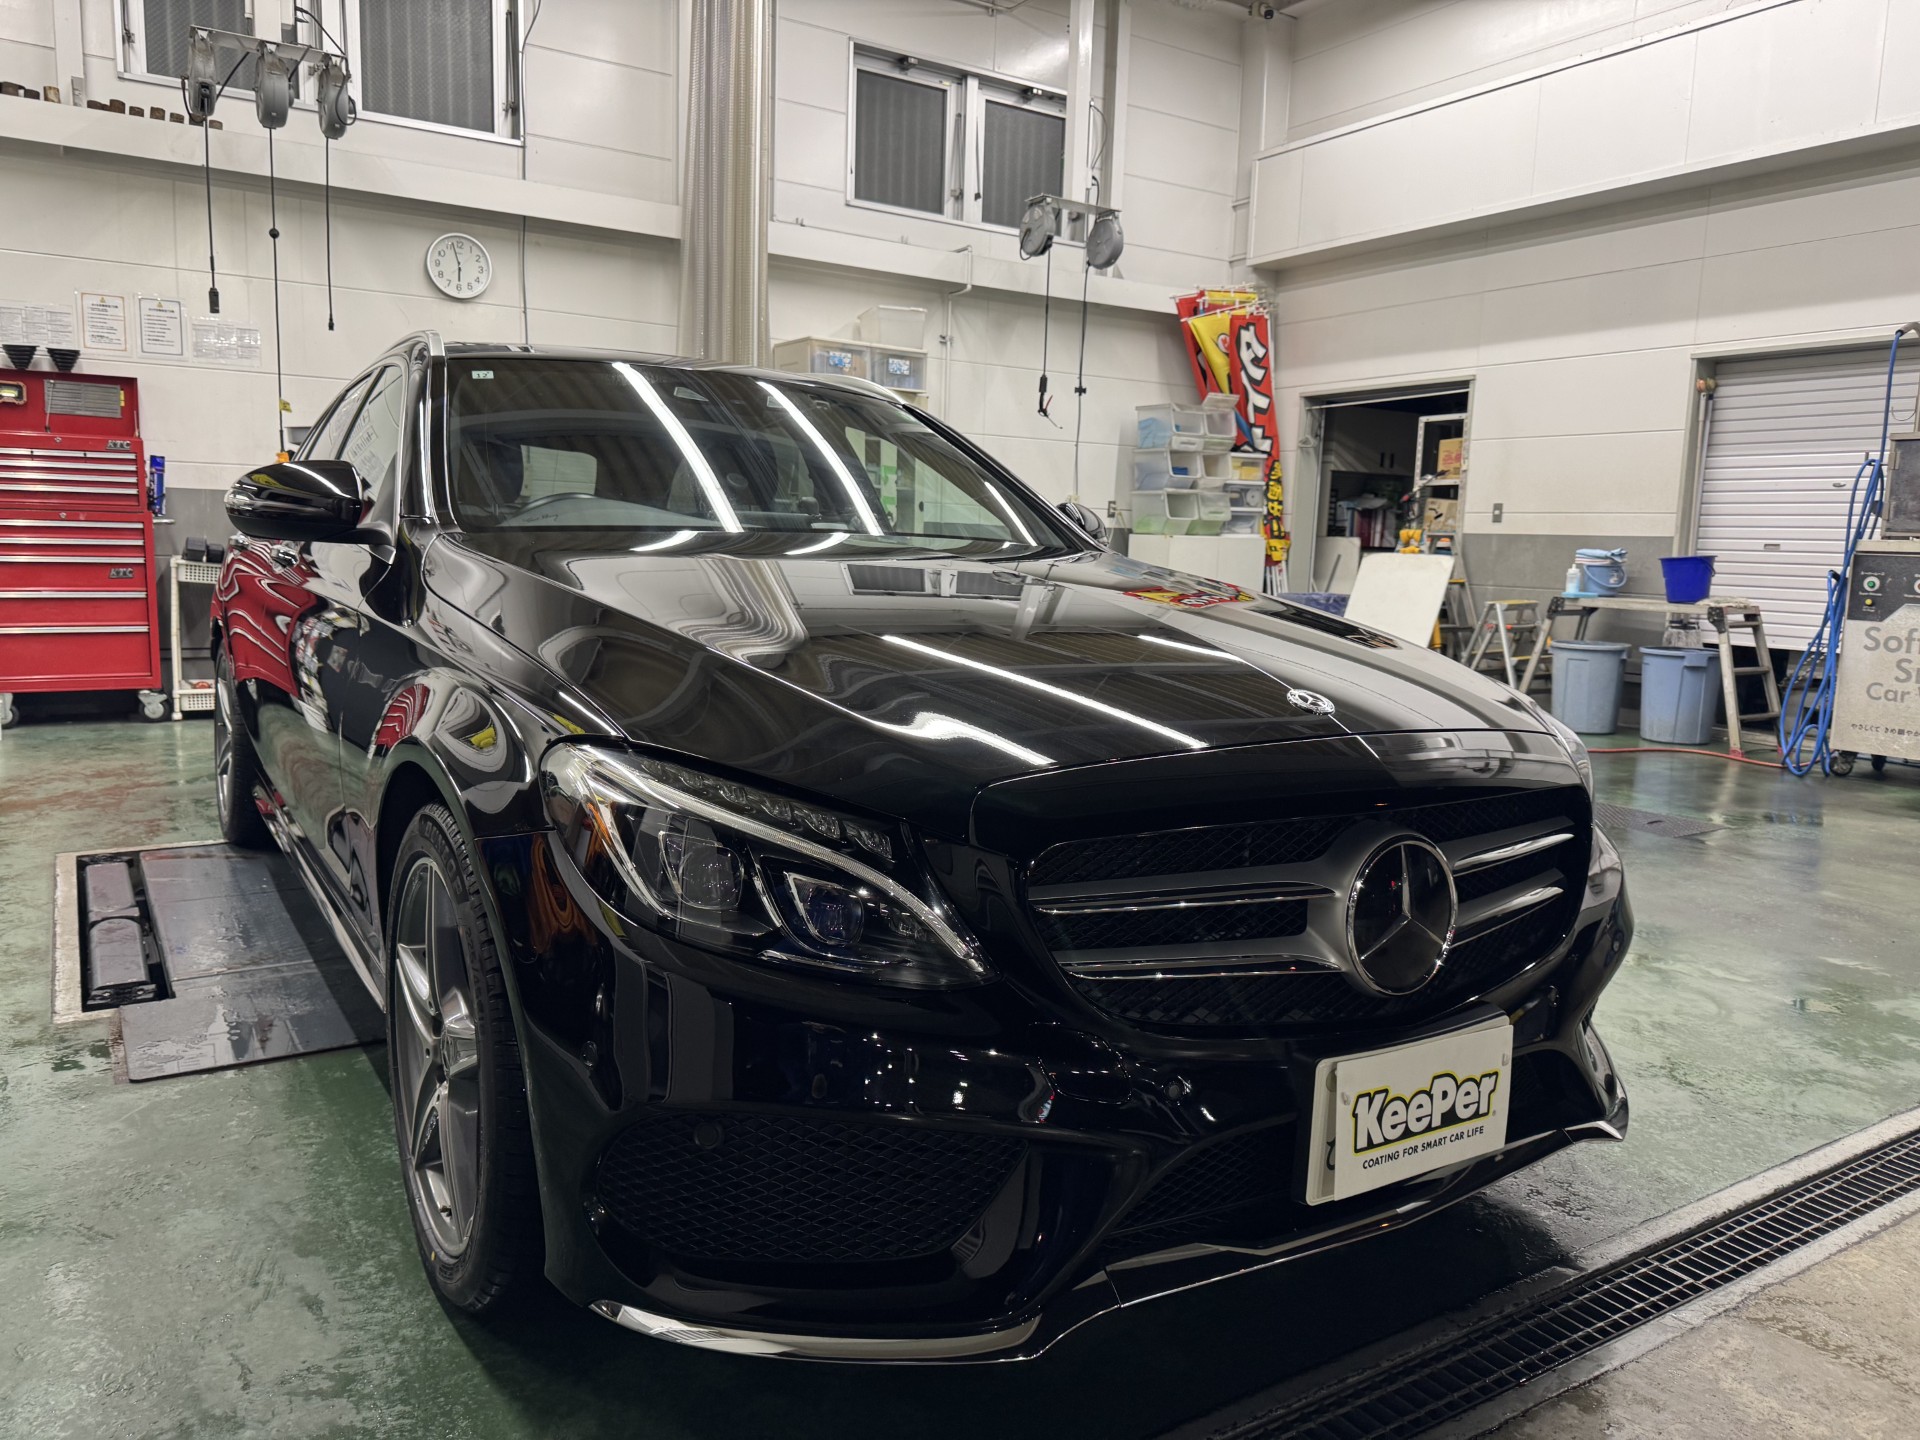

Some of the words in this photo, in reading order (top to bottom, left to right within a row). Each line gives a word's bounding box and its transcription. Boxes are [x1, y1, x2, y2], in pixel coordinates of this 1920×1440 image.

[456, 241, 464, 249] 12
[107, 439, 132, 449] KTC
[109, 567, 134, 578] KTC
[1866, 681, 1910, 704] Car
[424, 821, 463, 895] DUNLOP
[1352, 1071, 1498, 1154] KeePer
[1362, 1150, 1400, 1170] COATING
[1402, 1145, 1419, 1158] FOR
[1421, 1135, 1448, 1152] SMART
[1449, 1132, 1465, 1143] CAR
[1466, 1125, 1485, 1138] LIFE
